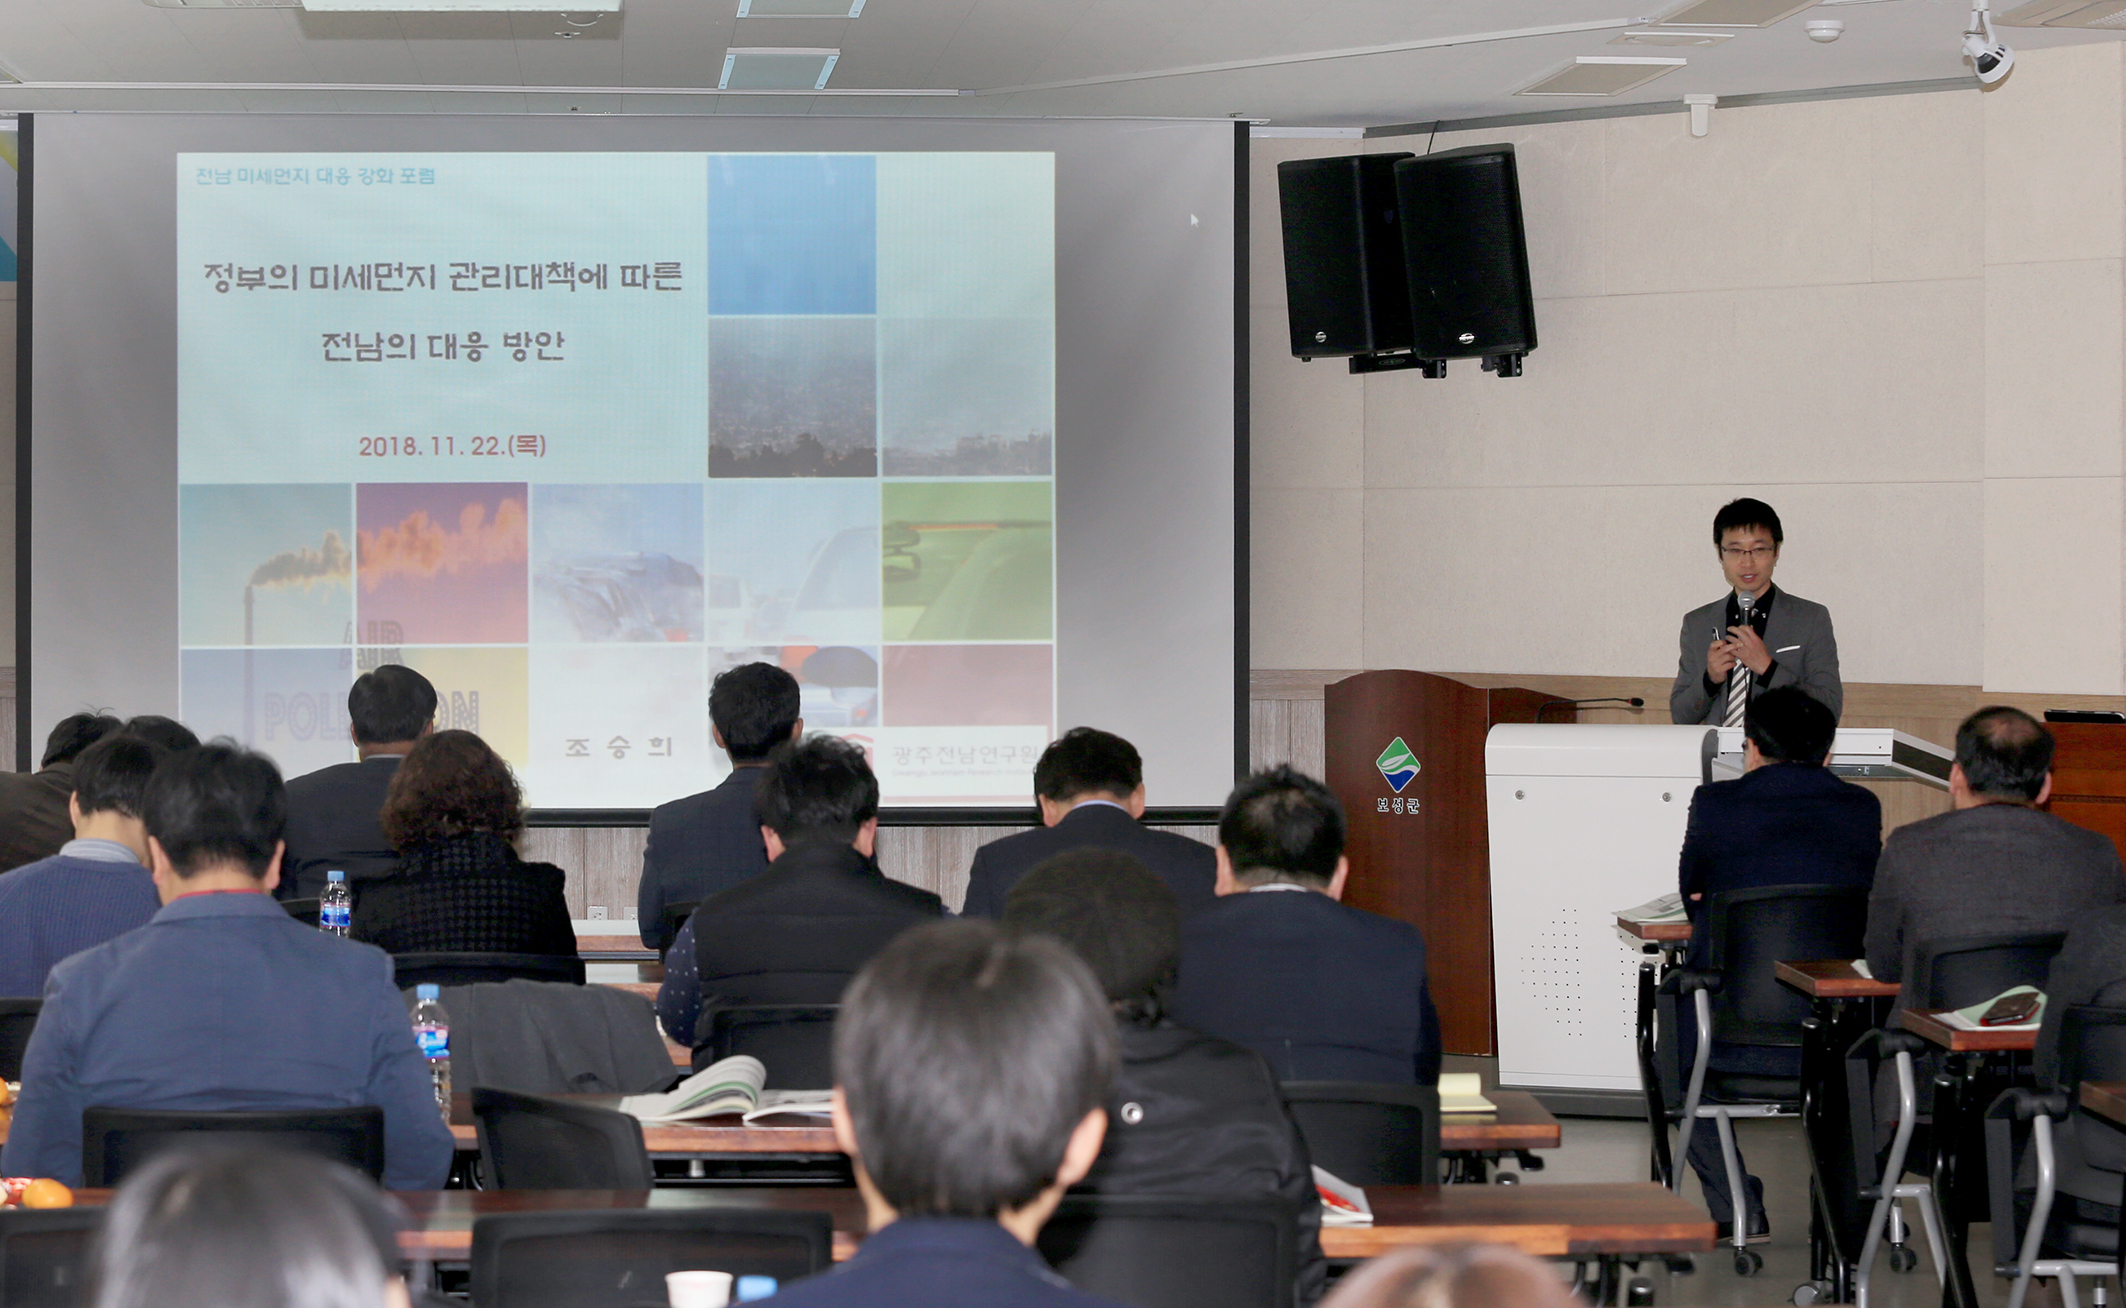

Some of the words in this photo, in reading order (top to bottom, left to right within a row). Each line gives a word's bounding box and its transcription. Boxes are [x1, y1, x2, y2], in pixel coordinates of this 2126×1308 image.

[196, 167, 232, 186] 전남
[237, 167, 310, 186] 미세먼지
[316, 167, 351, 186] 대응
[358, 167, 394, 186] 강화
[400, 167, 436, 186] 포럼
[204, 262, 298, 293] 정부의
[309, 261, 436, 292] 미세먼지
[449, 261, 607, 292] 관리대책에
[620, 261, 682, 291] 따른
[322, 331, 416, 362] 전남의
[427, 331, 489, 362] 대응
[503, 331, 565, 362] 방안
[338, 620, 405, 670] AIR
[892, 745, 1038, 766] 광주전남연구원
[1377, 797, 1420, 815] 보성군
